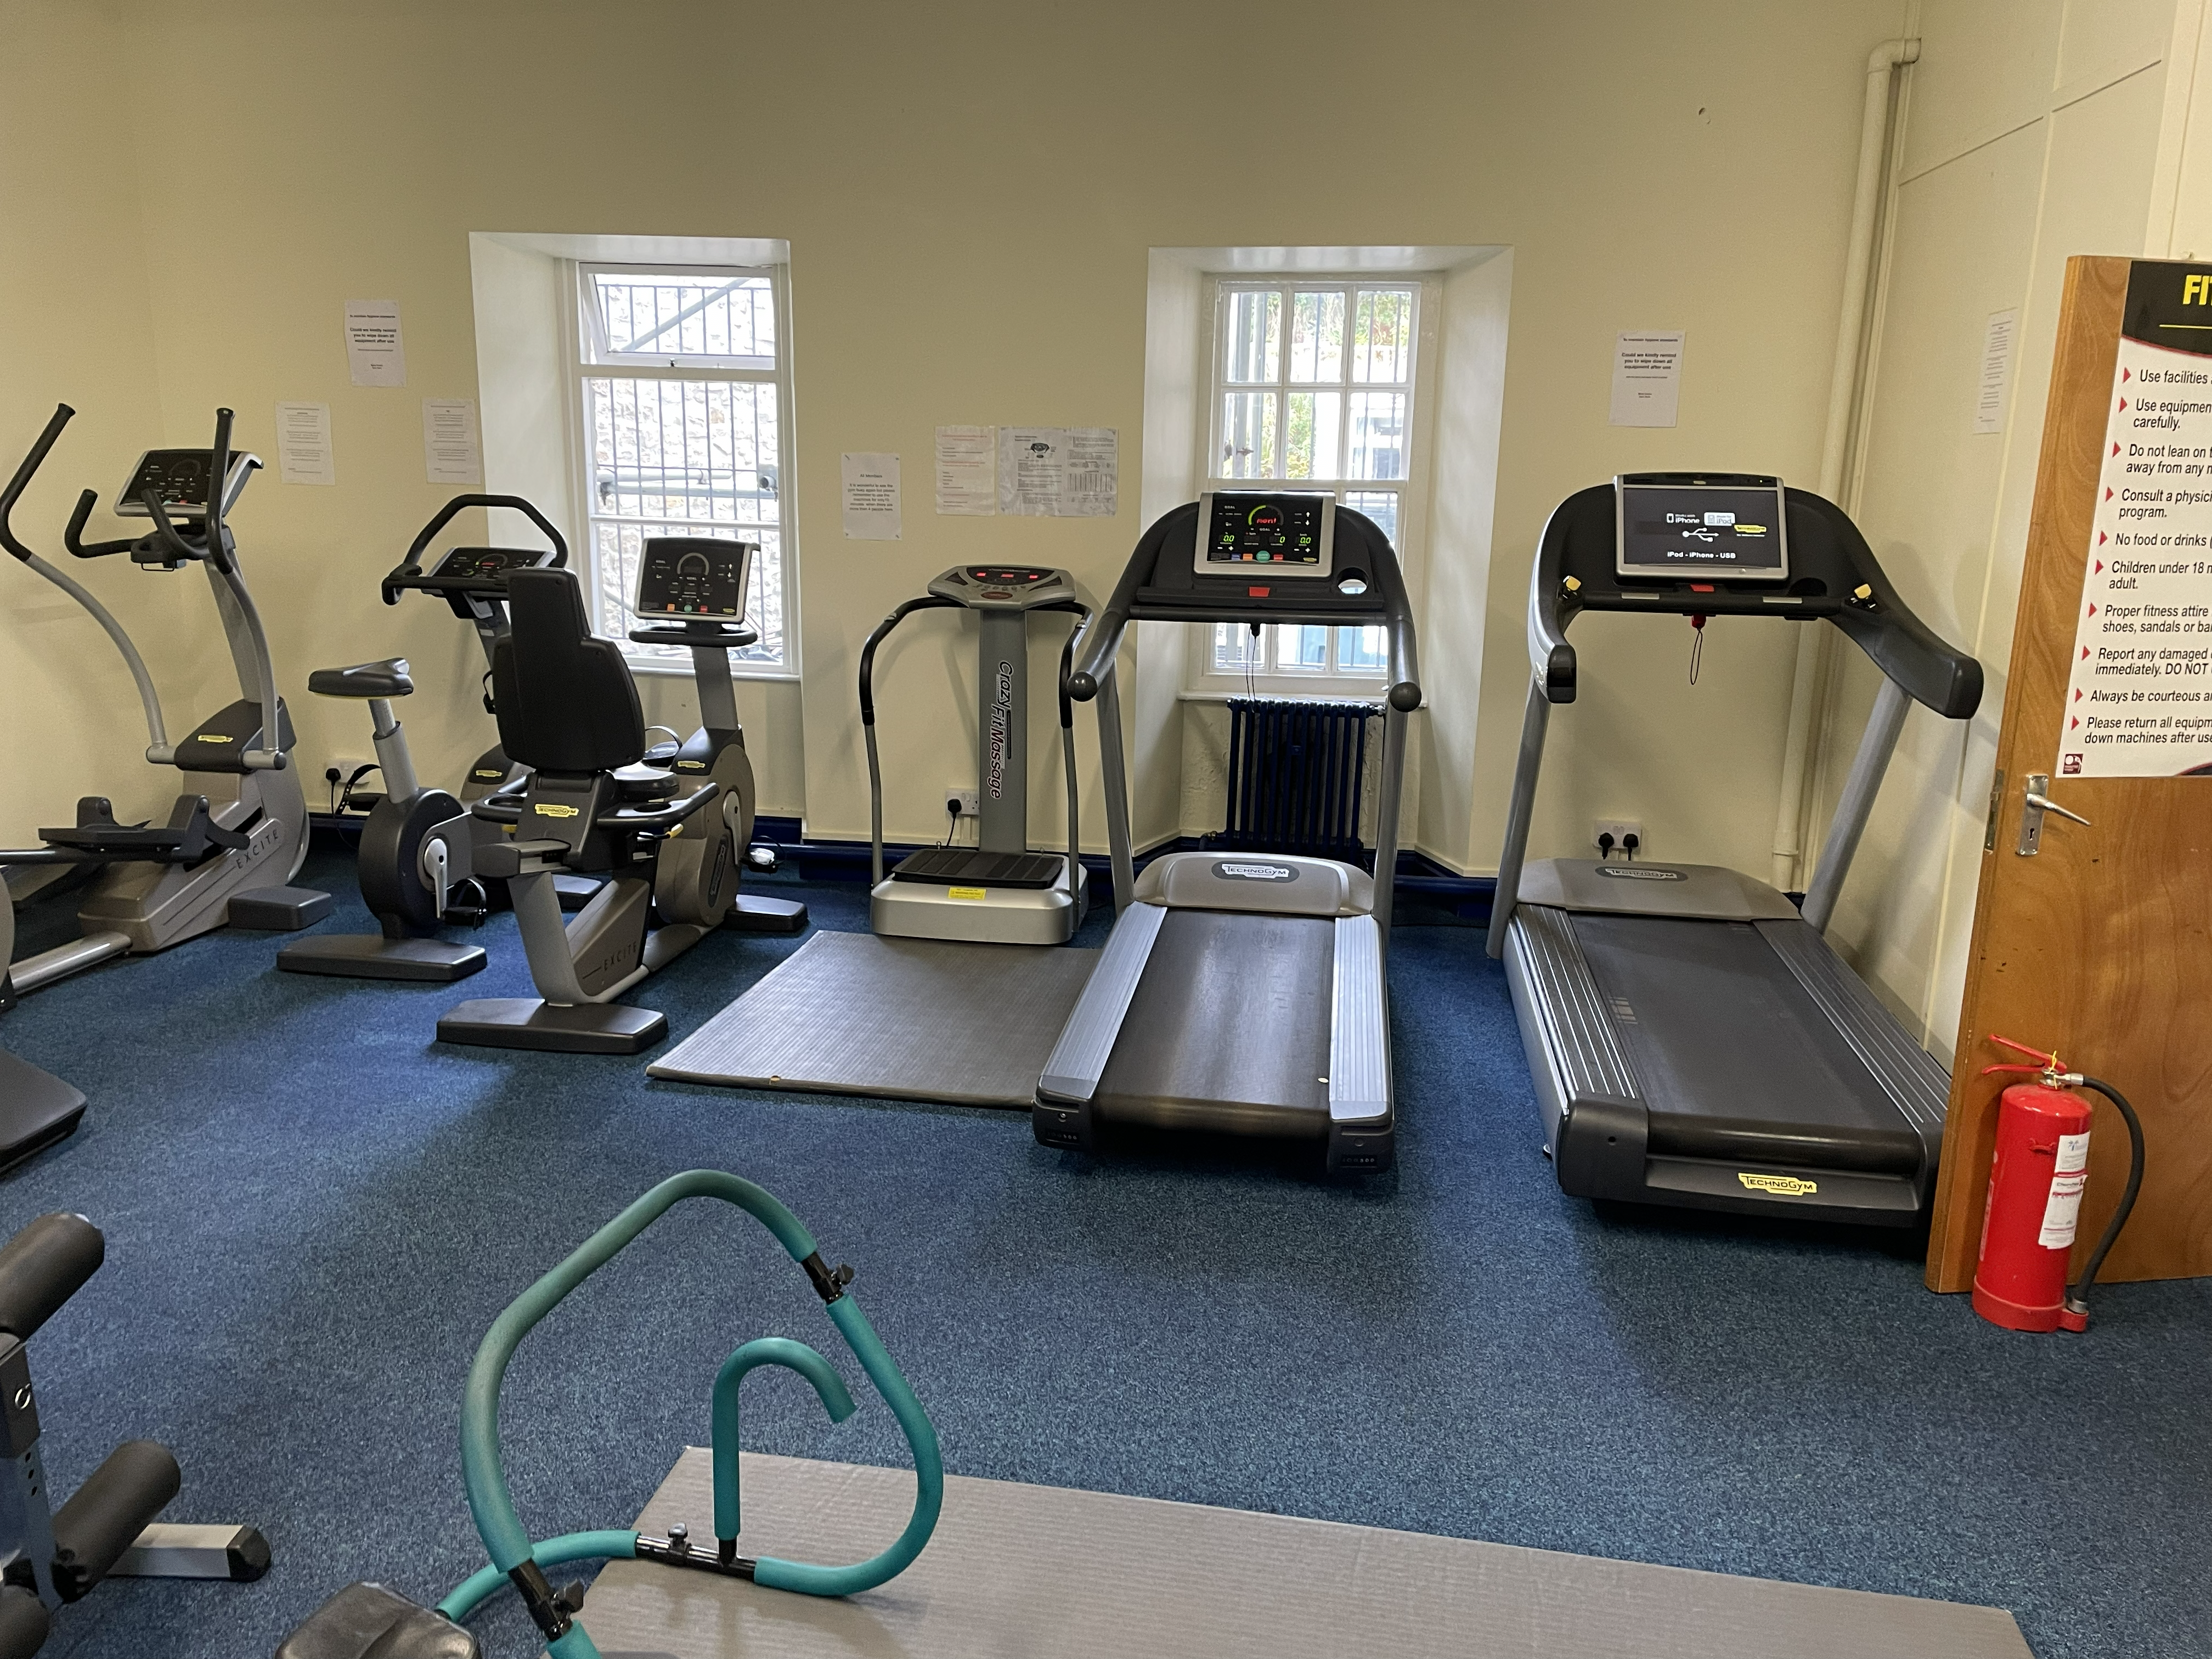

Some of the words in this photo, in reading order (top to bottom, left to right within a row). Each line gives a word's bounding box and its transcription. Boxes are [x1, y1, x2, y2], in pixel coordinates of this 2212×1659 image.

[2182, 274, 2212, 305] FI
[2140, 369, 2161, 382] Use
[2164, 369, 2208, 384] facilities
[2136, 398, 2157, 411] Use
[2133, 415, 2181, 432] carefully.
[2129, 444, 2144, 456] Do
[2147, 445, 2165, 457] not
[2168, 444, 2190, 458] lean
[2193, 448, 2207, 458] on
[2126, 462, 2155, 476] away
[2157, 460, 2182, 474] from
[2185, 464, 2204, 477] any
[2121, 488, 2164, 502] Consult
[2166, 493, 2172, 502] a
[2118, 507, 2168, 521] program.
[2115, 533, 2131, 545] No
[2133, 533, 2158, 546] food
[2160, 536, 2172, 546] or
[2174, 534, 2207, 546] drinks
[2112, 561, 2156, 574] Children
[2159, 562, 2190, 574] under
[2193, 562, 2204, 574] 18
[2109, 577, 2138, 590] adult.
[2104, 604, 2141, 619] Proper
[2143, 604, 2179, 617] fitness
[2181, 605, 2209, 617] attire
[2102, 620, 2137, 634] shoes,
[2140, 620, 2181, 633] sandals
[2183, 623, 2195, 632] or
[2098, 647, 2135, 662] Report
[2137, 650, 2157, 662] any
[2159, 647, 2209, 662] damaged
[2095, 663, 2162, 678] immediately.
[2165, 663, 2182, 675] DO
[2184, 663, 2209, 675] NOT
[997, 660, 1014, 709] Crazy
[2090, 690, 2129, 704] Always
[2131, 690, 2145, 702] be
[2147, 690, 2201, 702] courteous
[991, 703, 1006, 729] Fit
[2087, 716, 2121, 729] Please
[2124, 717, 2157, 729] return
[2159, 716, 2172, 728] all
[2084, 732, 2113, 743] down
[2116, 731, 2168, 743] machines
[2170, 731, 2196, 743] after
[987, 726, 1005, 799] Massage
[235, 828, 278, 869] EXCITE
[604, 940, 636, 971] EXCITE
